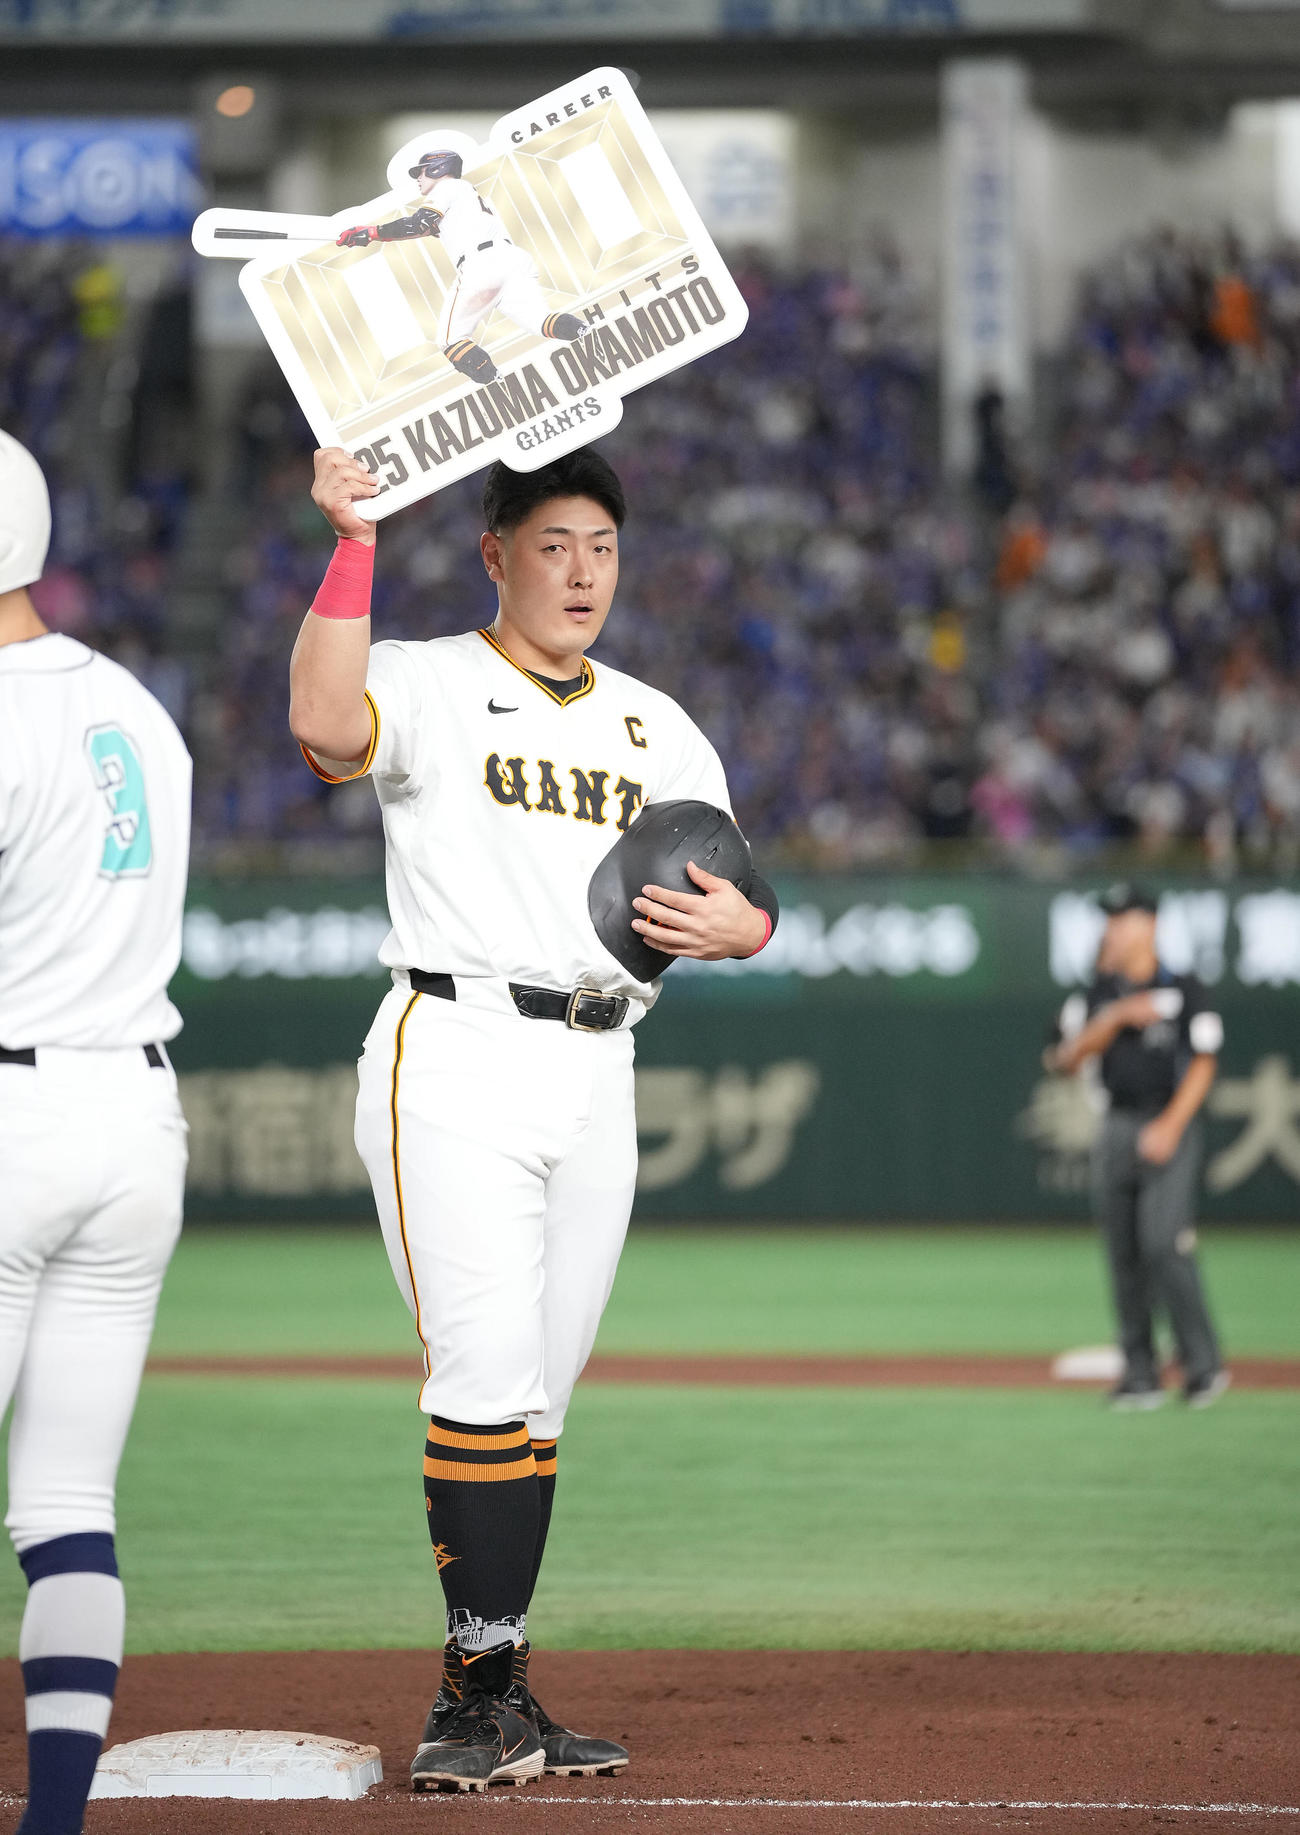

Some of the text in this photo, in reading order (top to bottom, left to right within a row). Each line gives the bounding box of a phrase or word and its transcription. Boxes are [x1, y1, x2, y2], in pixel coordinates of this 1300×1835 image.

[510, 84, 613, 144] CAREER
[582, 254, 700, 326] HITS
[401, 363, 560, 473] KAZUMA
[549, 276, 726, 397] OKAMOTO
[516, 396, 602, 452] GIANTS
[624, 715, 648, 749] C
[483, 751, 650, 833] GIANT
